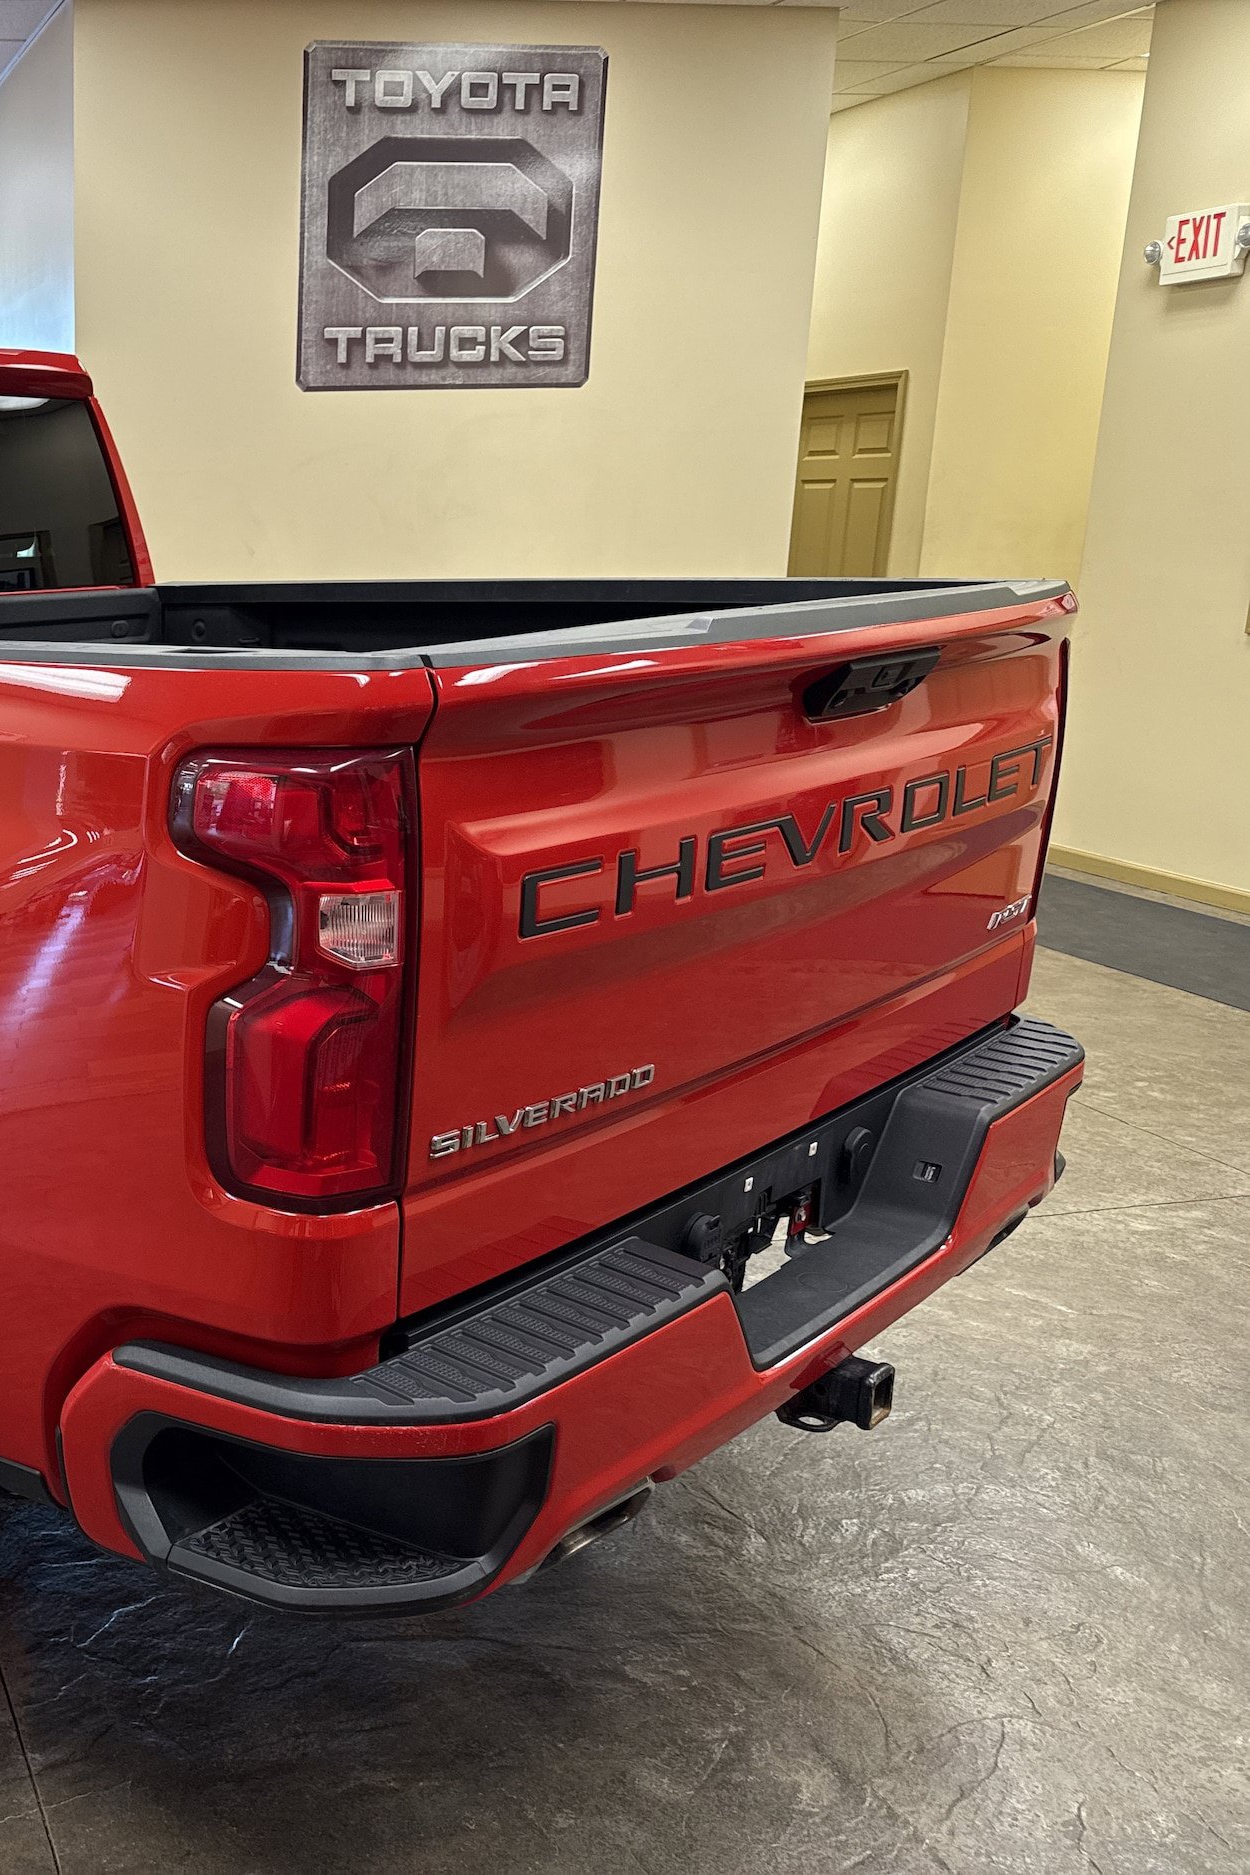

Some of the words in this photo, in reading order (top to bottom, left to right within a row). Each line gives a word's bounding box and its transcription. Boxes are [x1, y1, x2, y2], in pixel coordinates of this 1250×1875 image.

[332, 69, 580, 111] TOYOTA
[1174, 212, 1226, 264] EXIT
[324, 326, 566, 363] TRUCKS
[518, 737, 1052, 941] CHEVROLET
[986, 894, 1032, 931] RST
[429, 1063, 655, 1160] SILVERADO
